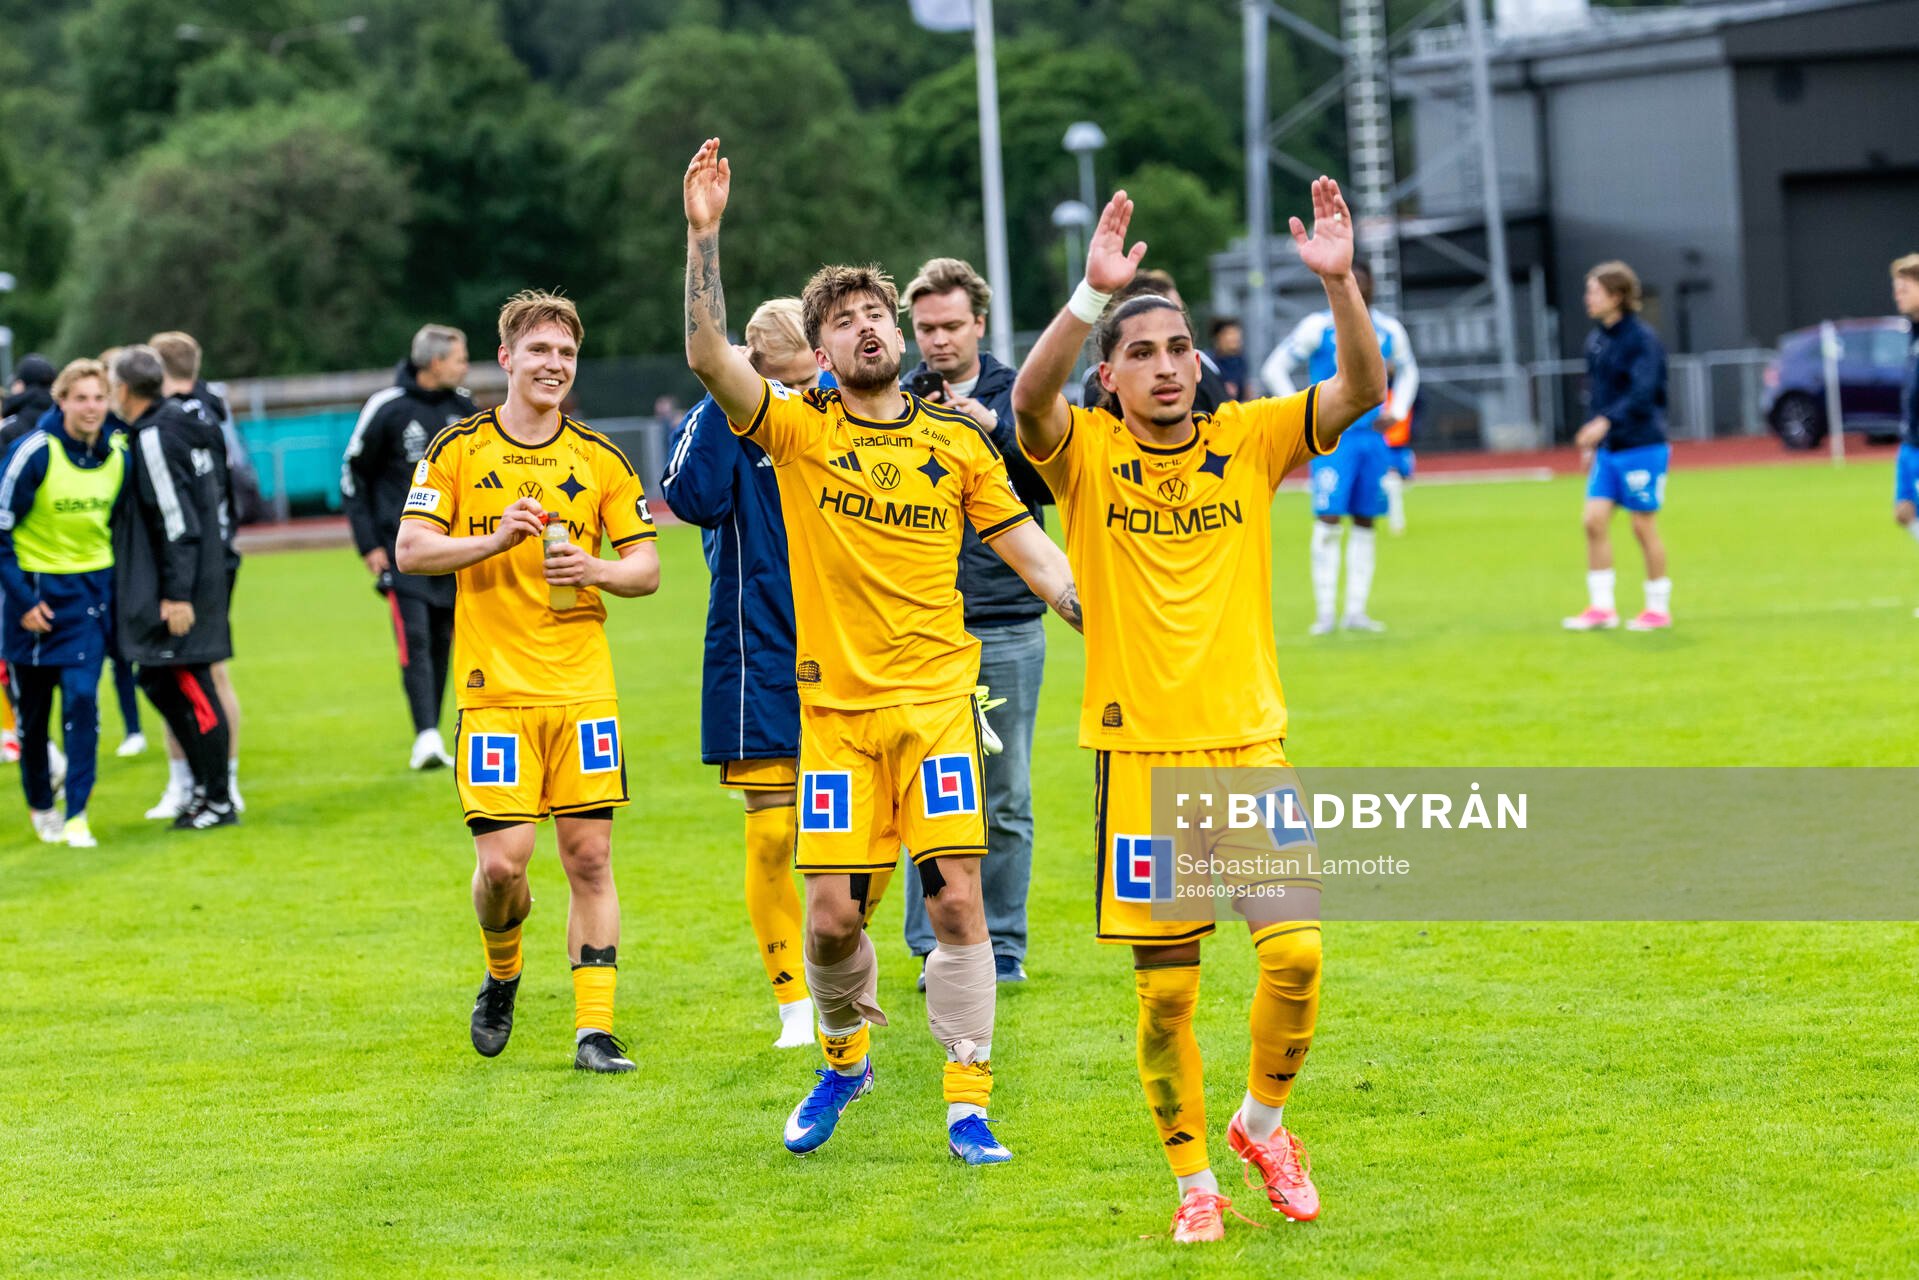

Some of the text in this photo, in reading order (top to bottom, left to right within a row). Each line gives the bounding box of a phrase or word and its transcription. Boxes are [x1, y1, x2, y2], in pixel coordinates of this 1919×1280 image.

[853, 434, 913, 448] stadium
[931, 430, 952, 447] bilia
[502, 453, 558, 467] stadium
[819, 487, 948, 531] HOLMEN
[1106, 499, 1243, 535] HOLMEN
[767, 939, 788, 954] IFK
